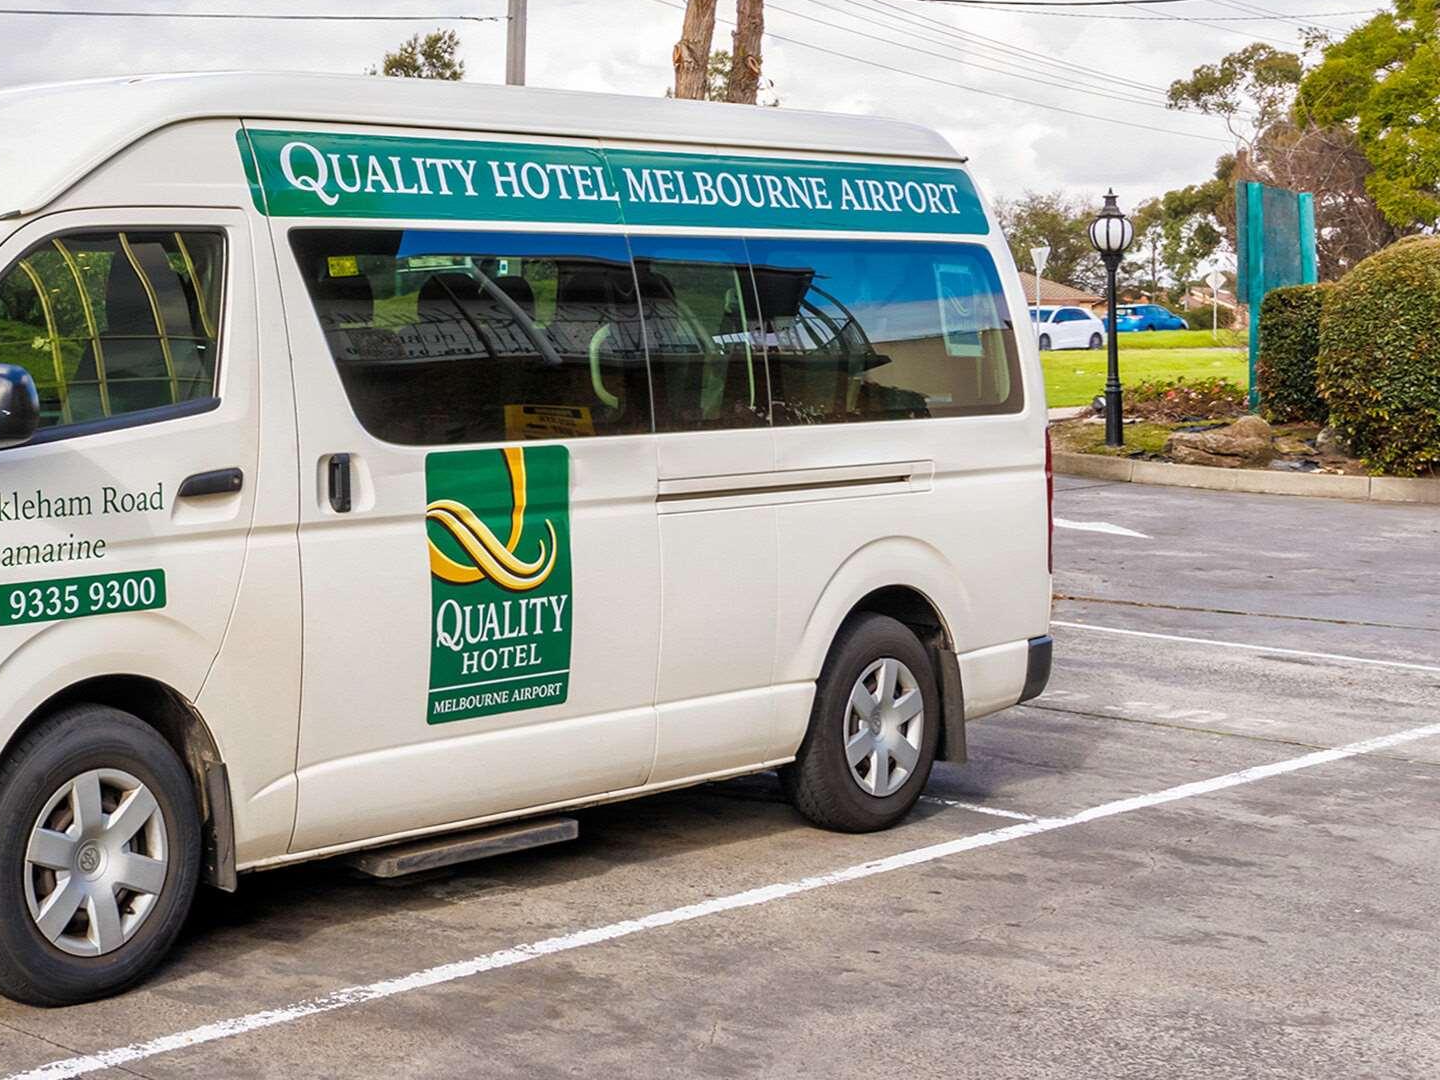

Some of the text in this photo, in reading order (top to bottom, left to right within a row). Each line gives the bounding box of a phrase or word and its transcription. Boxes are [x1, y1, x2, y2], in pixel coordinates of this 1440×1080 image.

[280, 141, 961, 215] QUALITY HOTEL MELBOURNE AIRPORT
[101, 482, 164, 514] Road
[9, 585, 80, 620] 9335
[89, 577, 156, 611] 9300
[436, 594, 568, 651] QUALITY
[461, 643, 542, 675] HOTEL
[433, 683, 563, 714] MELBOURNE AIRPORT
